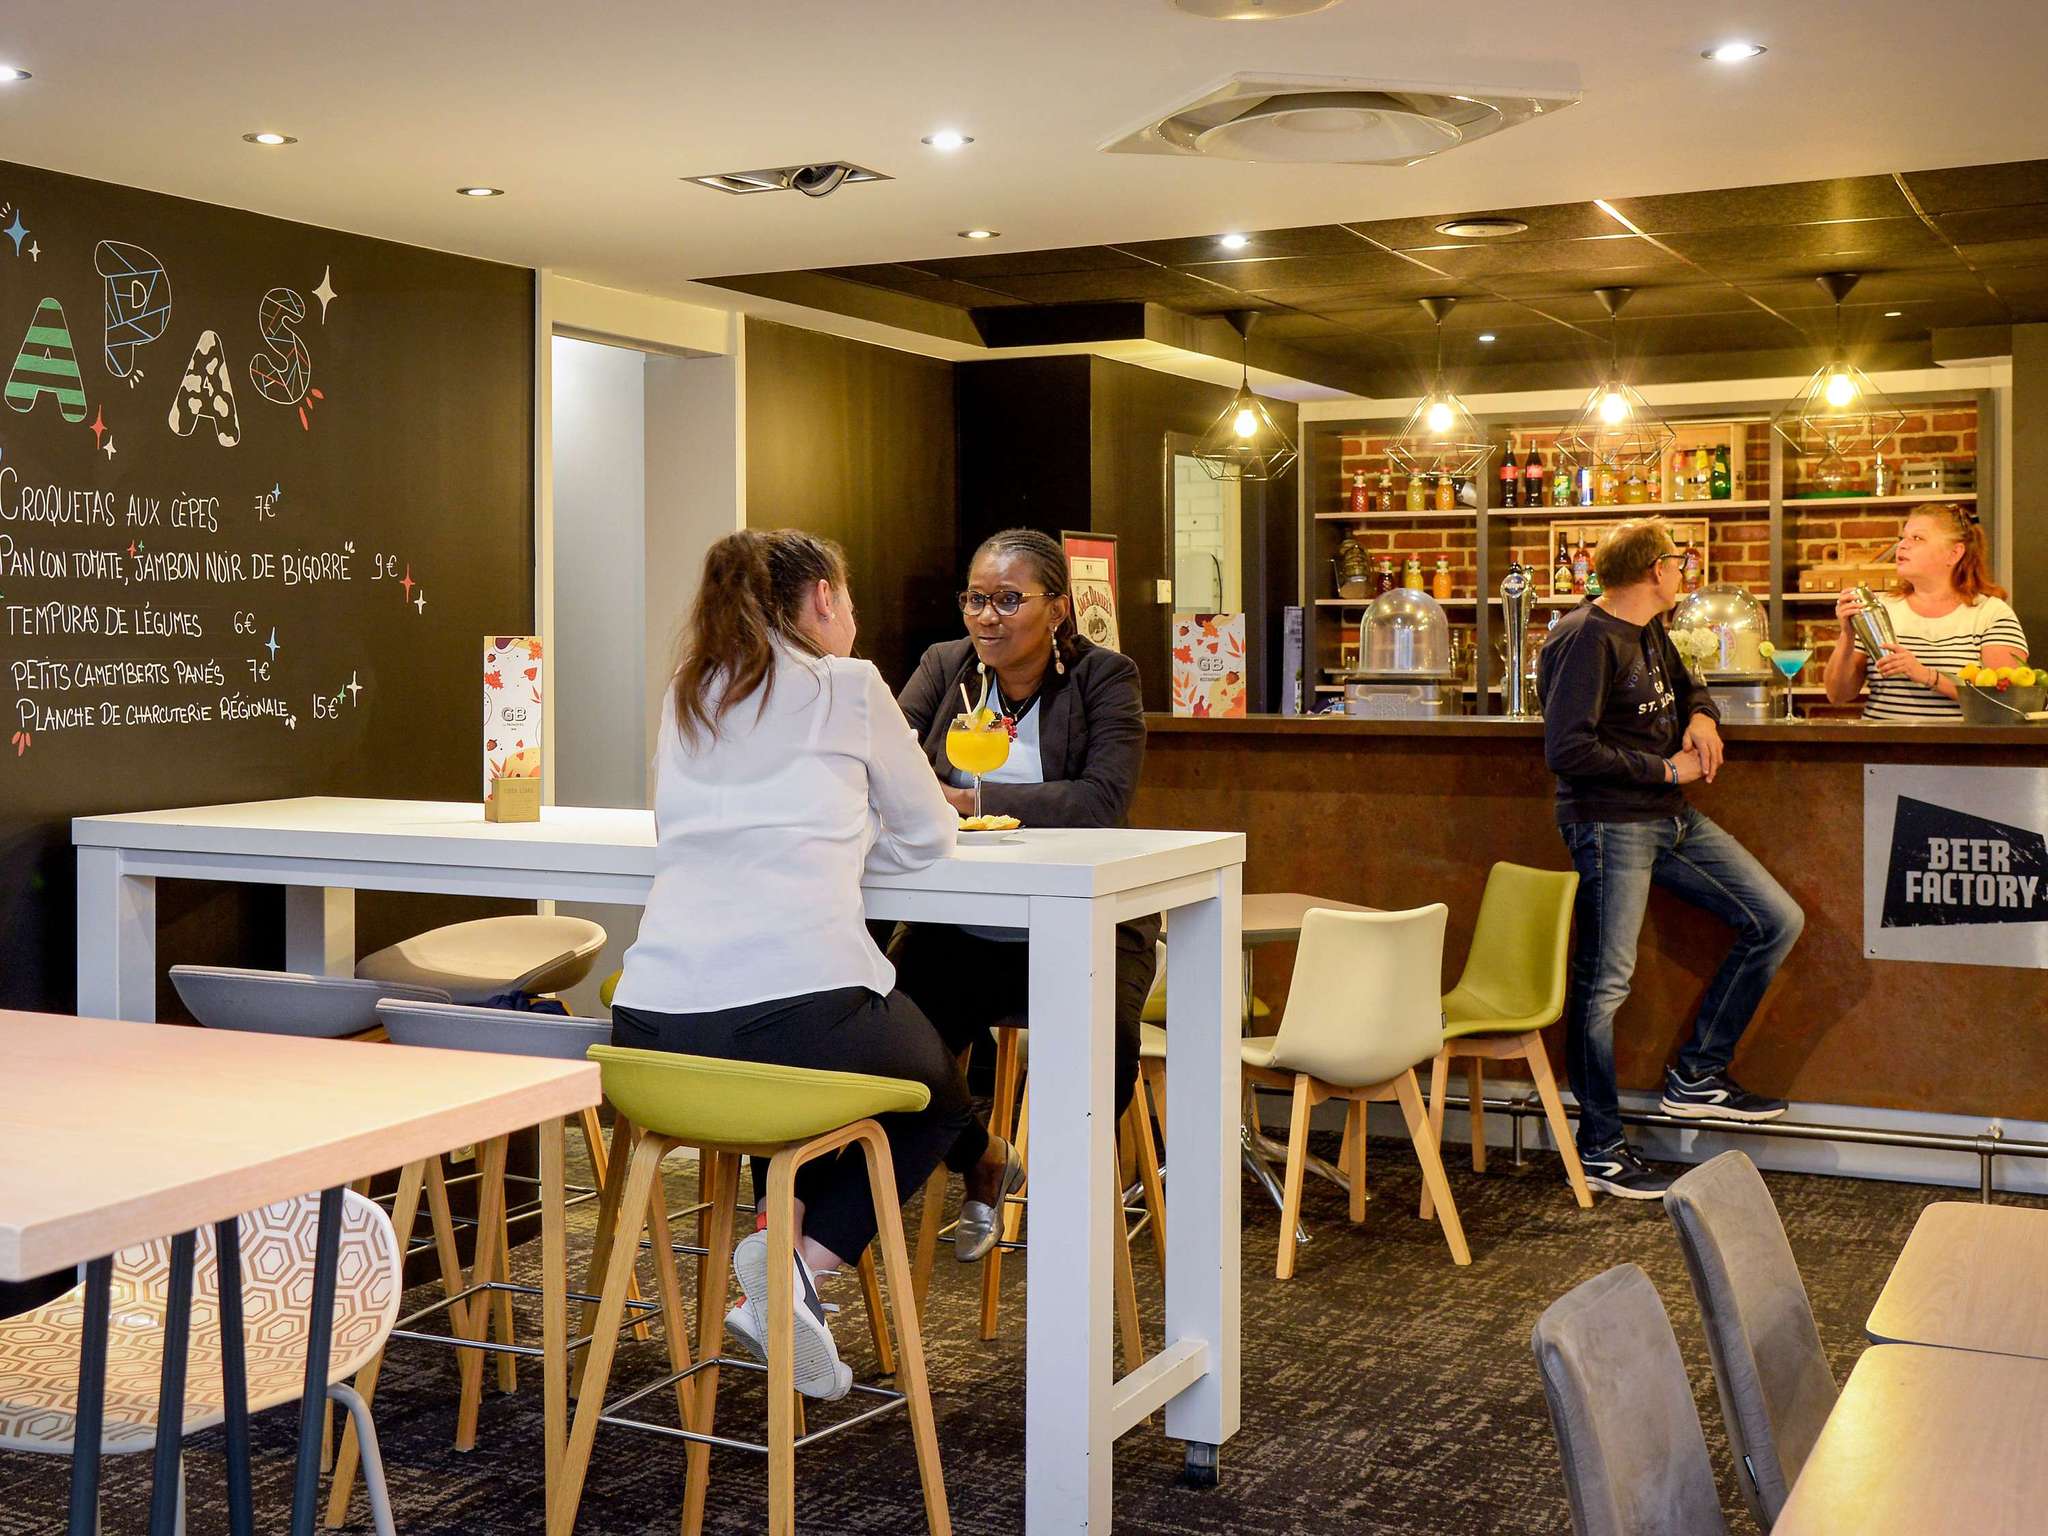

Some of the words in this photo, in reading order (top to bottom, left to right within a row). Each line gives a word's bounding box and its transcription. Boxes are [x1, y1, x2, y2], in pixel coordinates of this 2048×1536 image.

[0, 467, 115, 527] CROQUETAS
[127, 495, 160, 527] AUX
[171, 492, 219, 533] CÈPES
[255, 493, 276, 521] 7€
[0, 534, 35, 577] PAN
[40, 550, 66, 578] CON
[72, 549, 129, 586] TOMATE,
[134, 551, 200, 582] JAMBON
[206, 551, 247, 583] NOIR
[252, 554, 275, 580] DE
[282, 548, 351, 585] BIGORRE
[371, 553, 398, 580] 9€
[7, 602, 99, 635] TEMPURAS
[105, 606, 127, 635] DE
[135, 602, 202, 637] LÉGUMES
[233, 611, 256, 634] 6€
[11, 656, 71, 691] PETITS
[75, 662, 169, 687] CAMEMBERTS
[174, 659, 225, 686] PANÉS
[247, 660, 271, 683] 7€
[1199, 657, 1224, 672] GB
[16, 698, 95, 731] PLANCHE
[100, 703, 121, 726] DE
[126, 703, 212, 726] CHARCUTERIE
[220, 692, 288, 721] RÉGIONALE
[314, 694, 339, 720] 15€
[502, 707, 527, 721] GB
[1927, 837, 2011, 873] BEER
[1906, 871, 2039, 909] FACTORY
